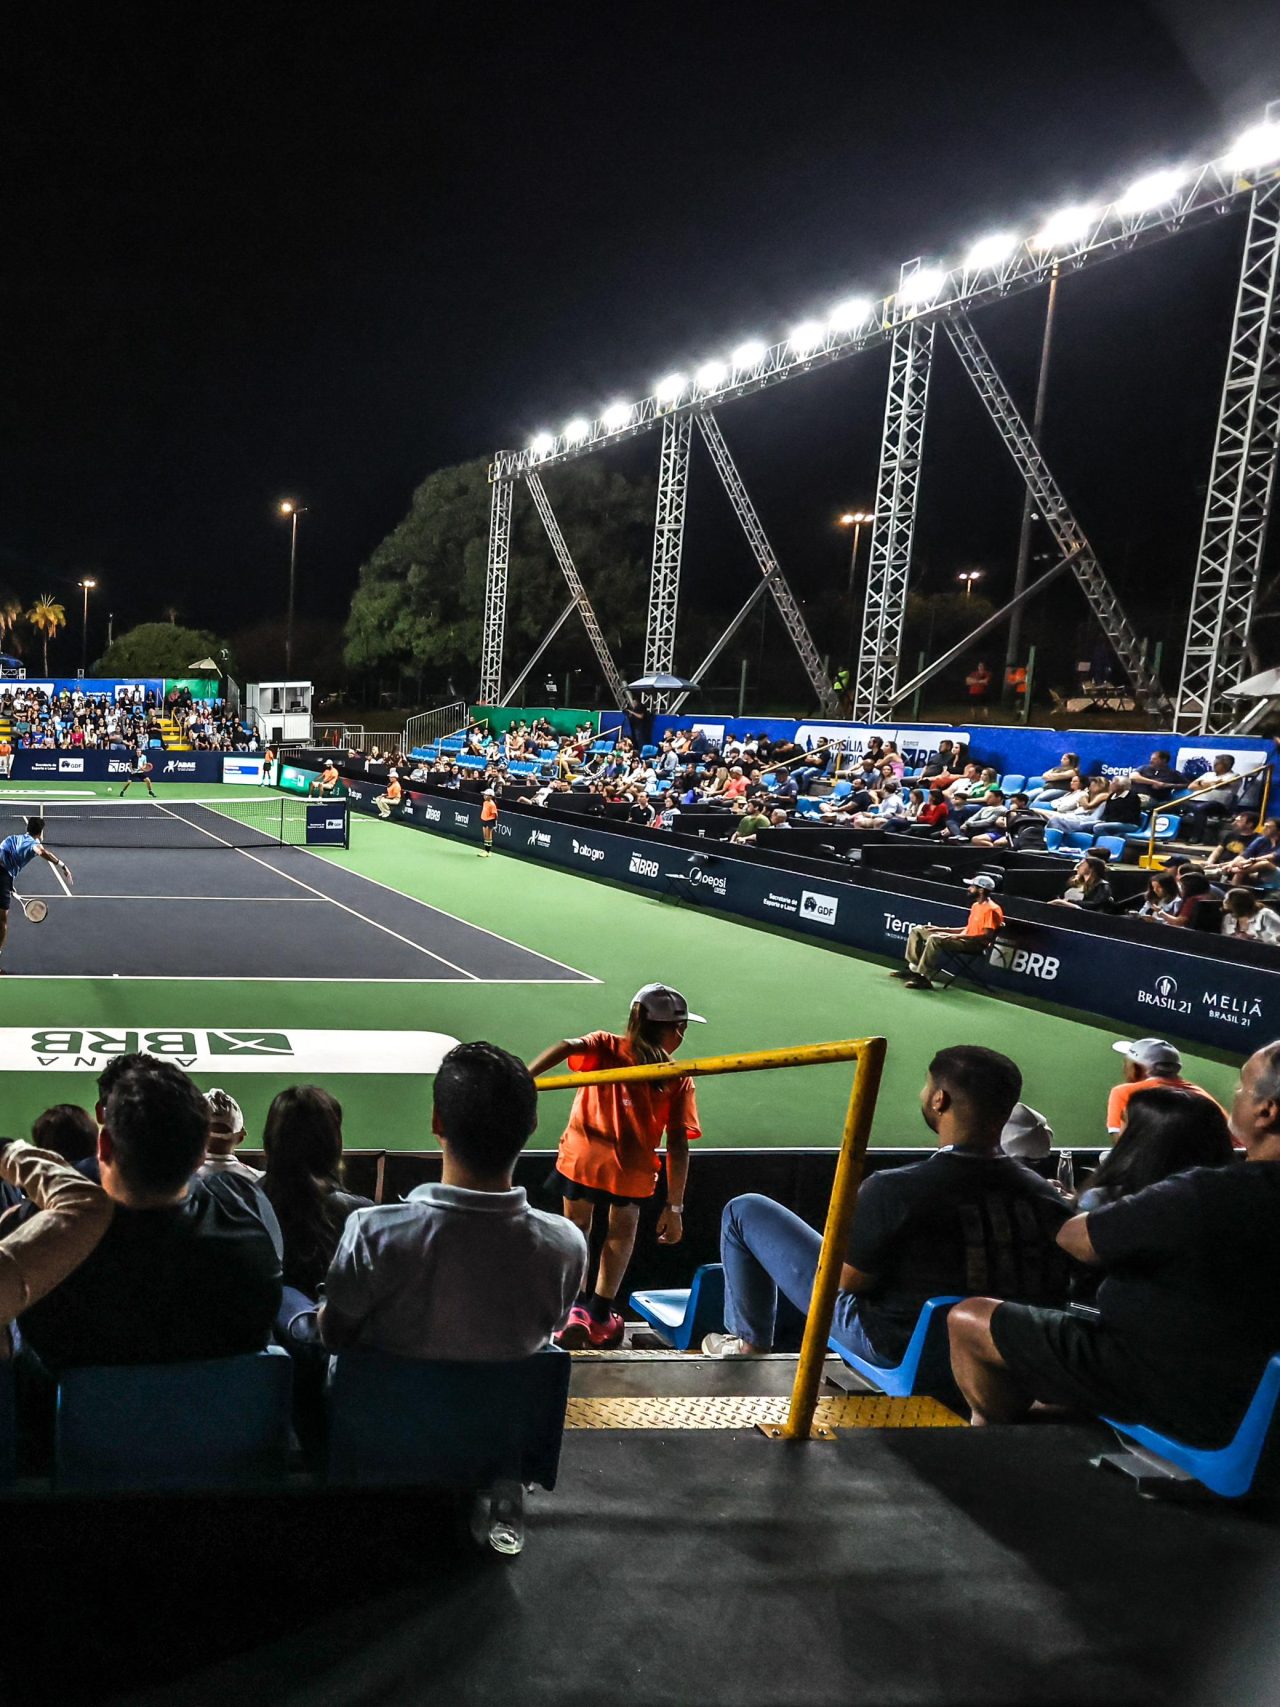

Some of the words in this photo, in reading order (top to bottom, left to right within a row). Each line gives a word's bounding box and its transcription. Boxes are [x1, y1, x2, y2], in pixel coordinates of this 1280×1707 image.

[828, 736, 863, 752] RASÍLIA
[119, 762, 132, 772] BR
[1101, 764, 1136, 776] Secret
[638, 859, 659, 878] BRB
[702, 874, 727, 888] pepsi
[769, 892, 791, 904] Secretaria
[817, 906, 834, 916] GDF
[884, 912, 932, 934] Terr
[1011, 949, 1060, 980] BRB
[1202, 992, 1262, 1017] MELIÃ
[1209, 1010, 1239, 1024] BRASIL
[1241, 1018, 1251, 1026] 21
[31, 1030, 197, 1055] BRB
[36, 1056, 198, 1067] ANA
